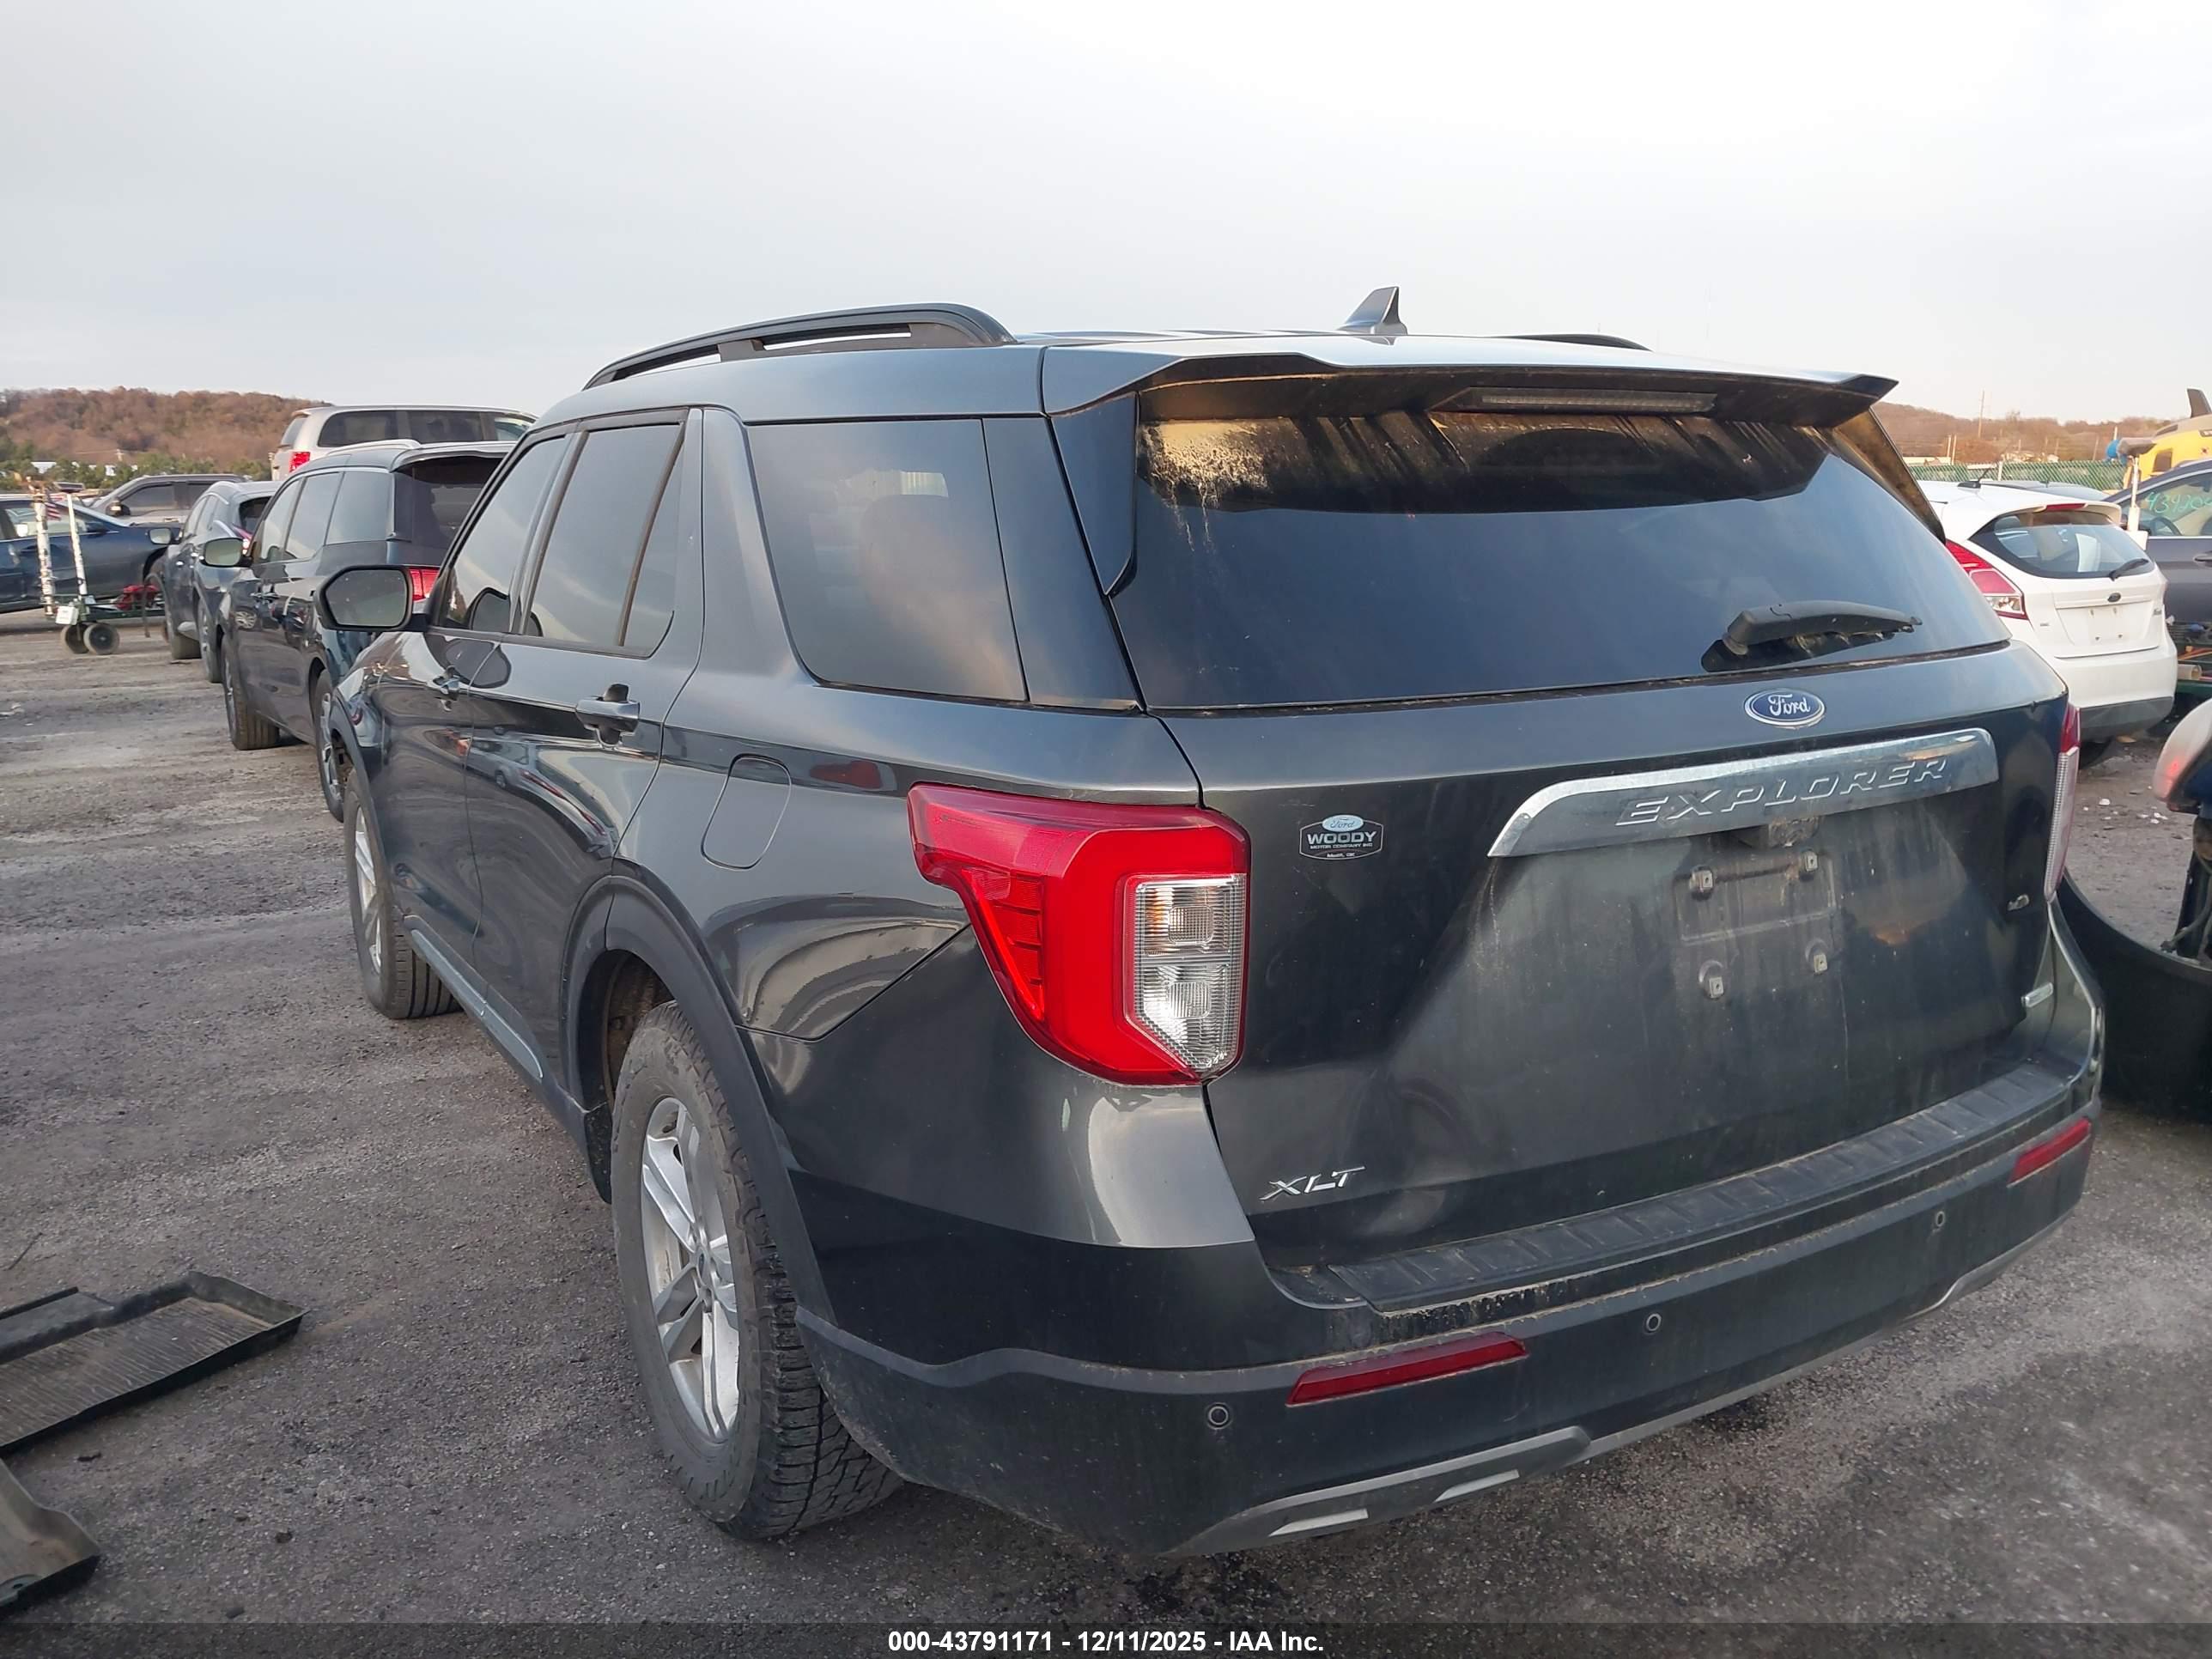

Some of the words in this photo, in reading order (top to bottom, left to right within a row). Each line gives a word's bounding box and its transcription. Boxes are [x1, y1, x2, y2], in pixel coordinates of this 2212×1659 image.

[1767, 693, 1811, 716] Ford
[1614, 758, 1948, 827] EXPLORER
[1306, 830, 1377, 845] WOODY
[1259, 1165, 1366, 1201] XLT
